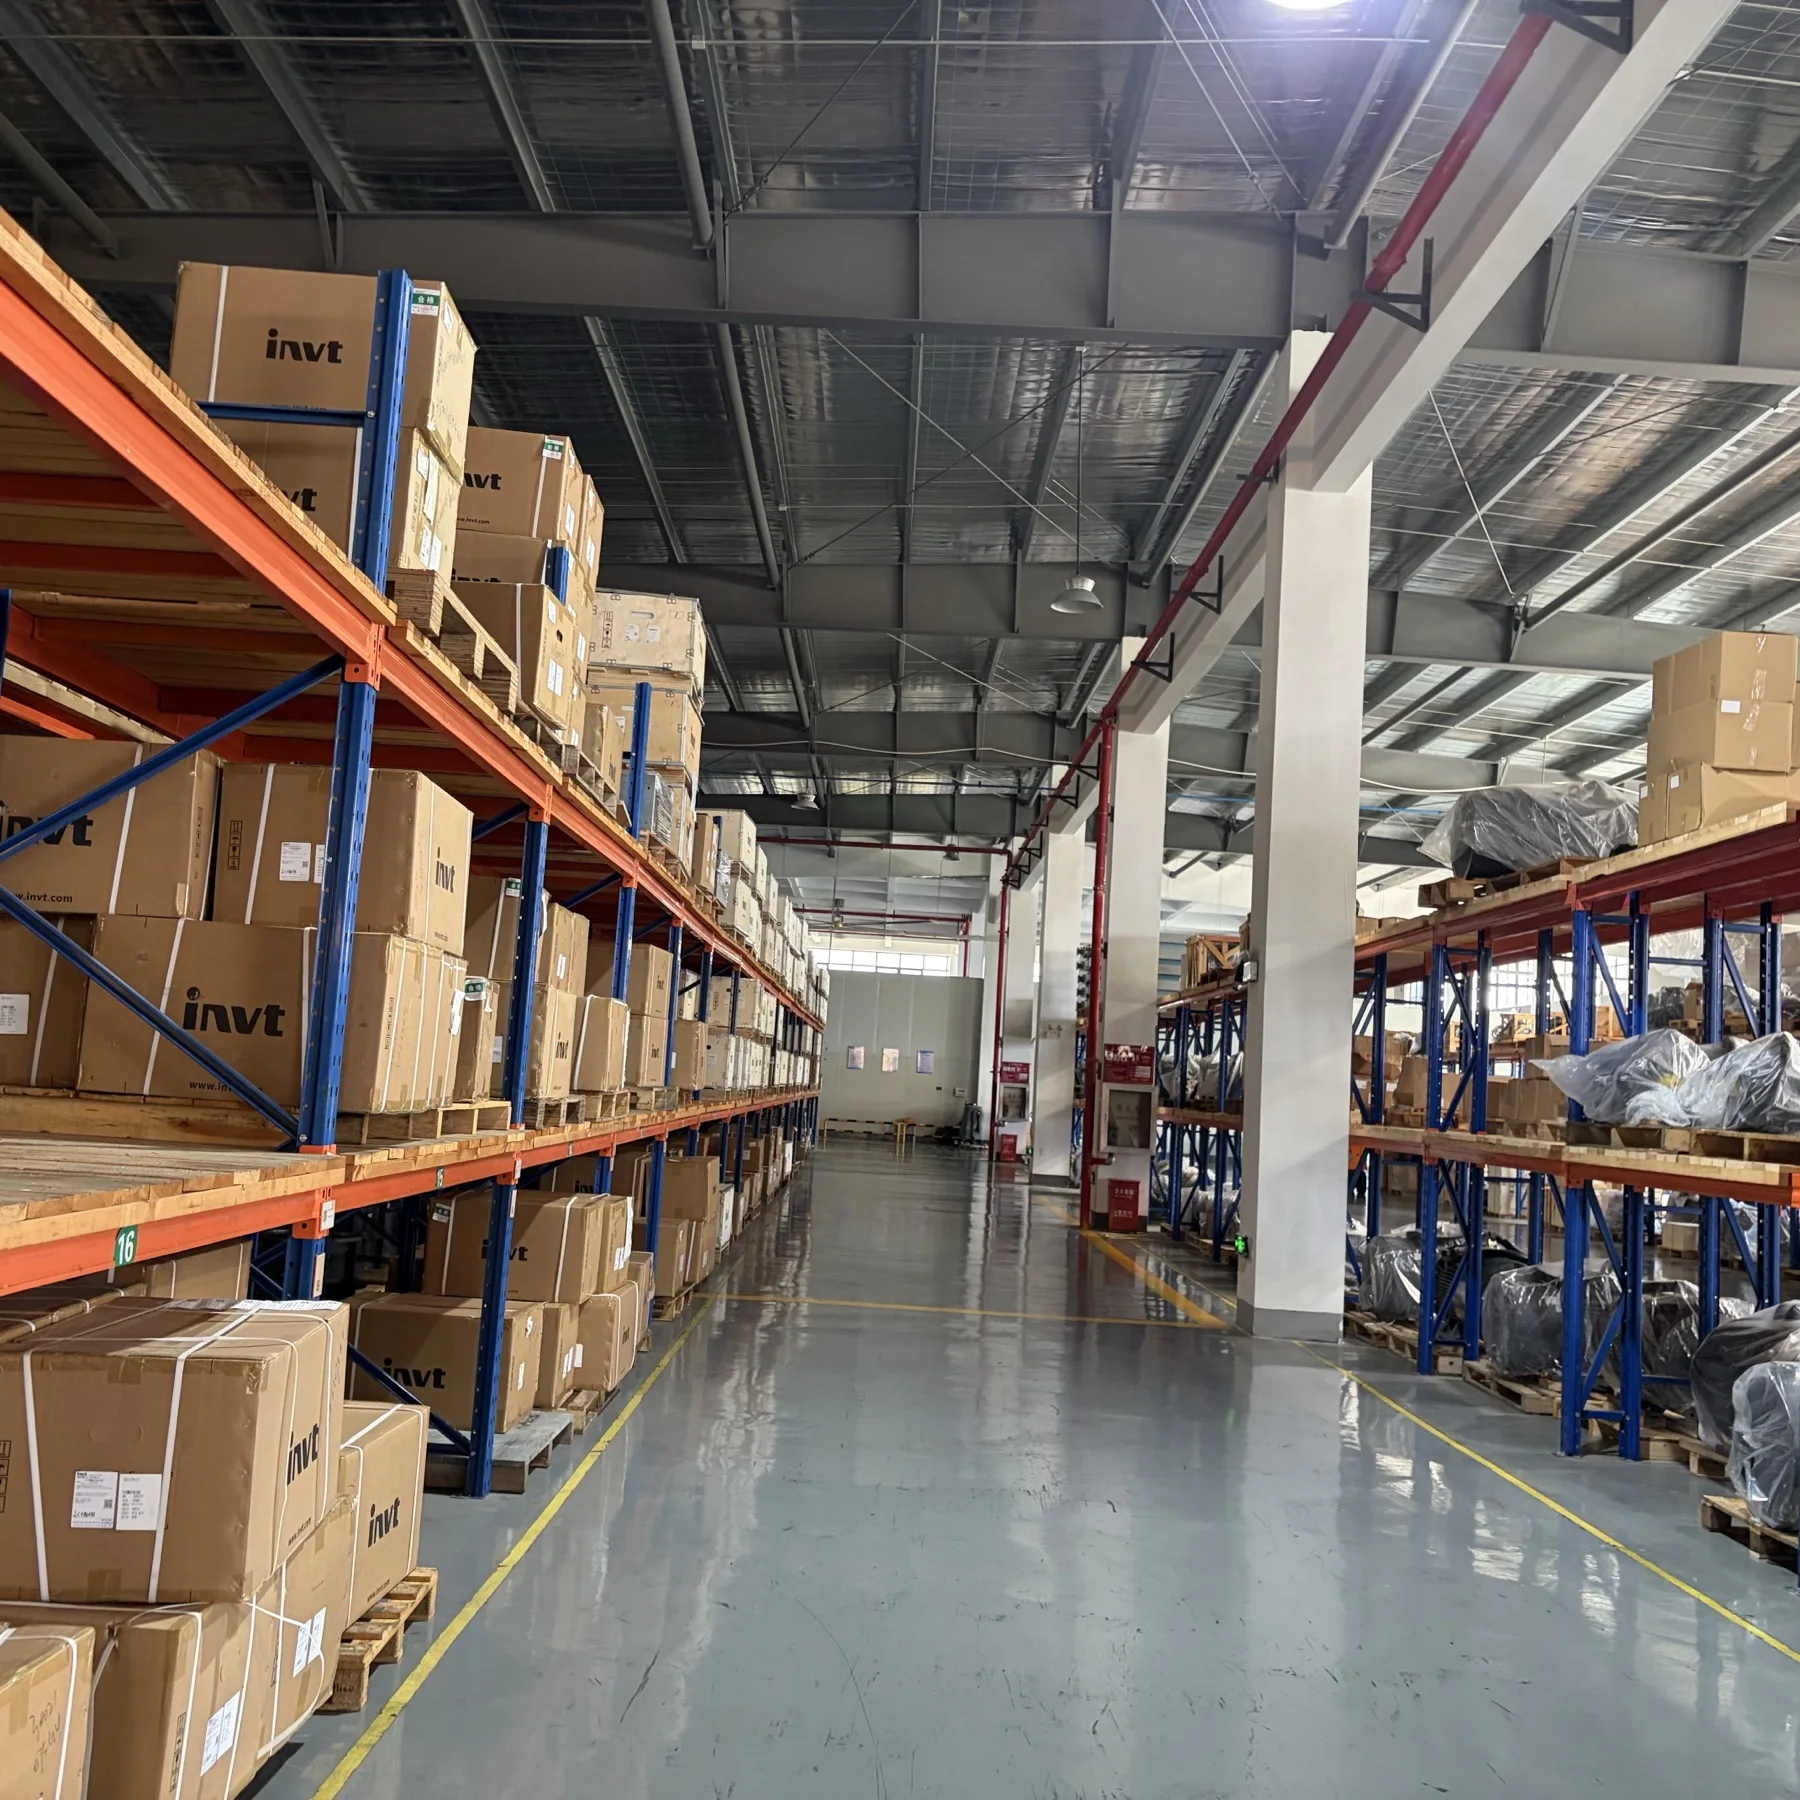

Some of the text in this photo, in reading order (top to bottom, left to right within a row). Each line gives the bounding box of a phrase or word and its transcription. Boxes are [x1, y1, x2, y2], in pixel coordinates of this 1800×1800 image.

[266, 328, 343, 364] invt
[435, 846, 455, 893] invt
[183, 986, 286, 1037] invt
[118, 1231, 135, 1265] 16
[383, 1357, 446, 1389] invt
[286, 1423, 320, 1486] invt
[368, 1497, 400, 1548] invt
